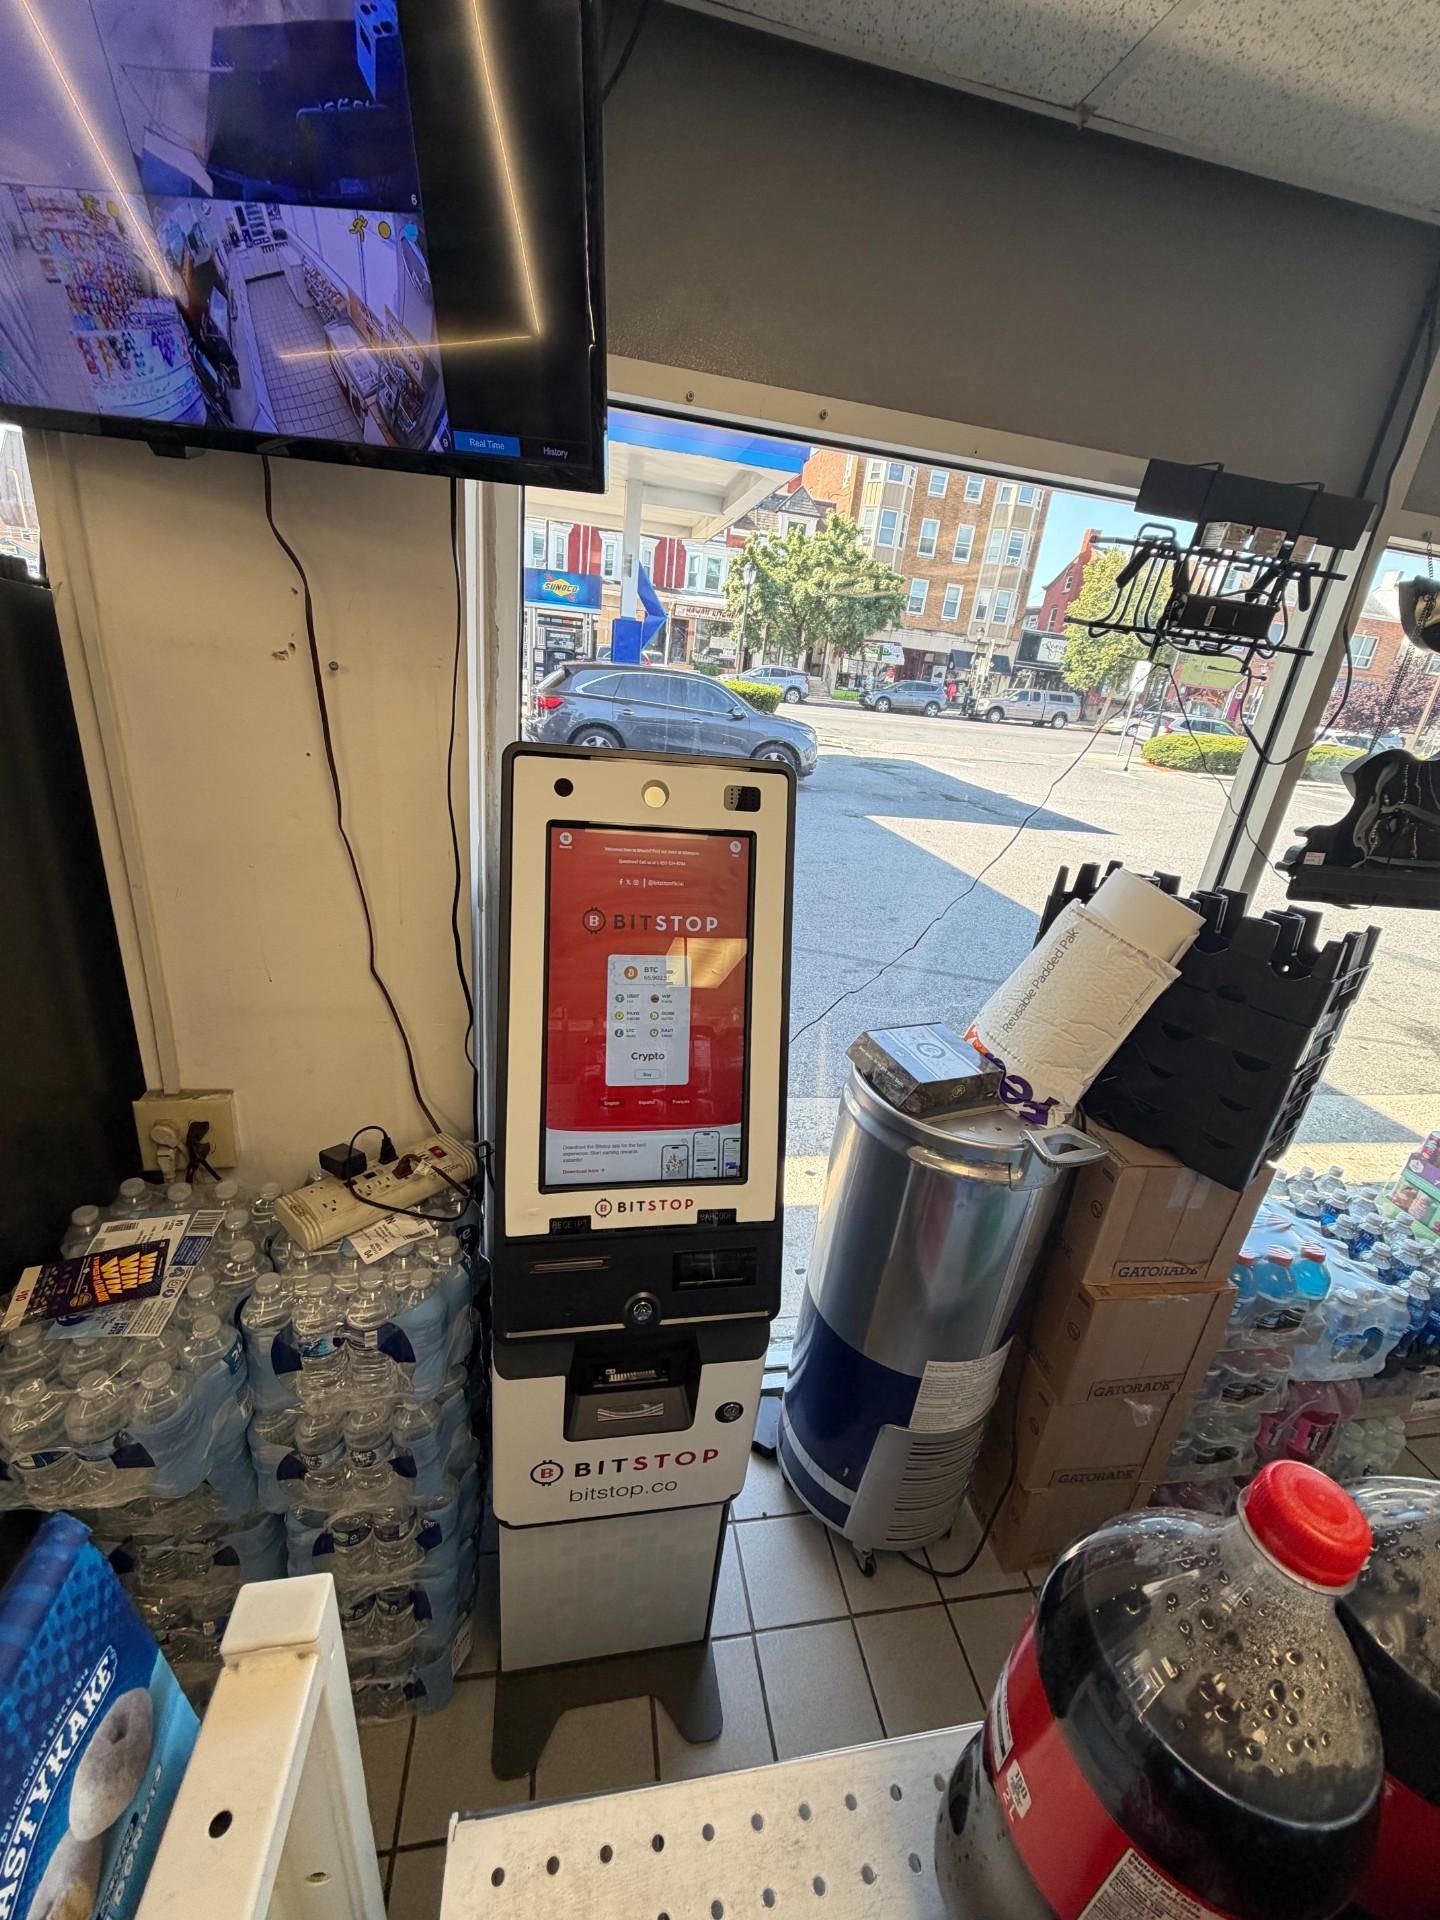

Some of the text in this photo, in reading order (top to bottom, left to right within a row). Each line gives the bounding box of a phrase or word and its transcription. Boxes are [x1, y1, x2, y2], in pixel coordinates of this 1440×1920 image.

[410, 193, 418, 206] 6
[469, 438, 505, 450] Real Time
[543, 446, 569, 460] History
[544, 582, 580, 594] SUNOCO
[613, 914, 719, 933] BITSTOP
[1002, 927, 1080, 1034] Reusable Padded Pak
[631, 1052, 665, 1062] Crypto
[617, 1198, 694, 1213] BITSTOP
[100, 1255, 123, 1294] WIN
[119, 1251, 141, 1291] WIN
[138, 1250, 159, 1286] WIN
[1117, 1266, 1199, 1278] GATORADE
[1093, 1380, 1176, 1398] GATORADE
[574, 1448, 720, 1478] BITSTOP
[1058, 1469, 1138, 1484] GATORADE
[569, 1480, 678, 1502] bitstop.co
[48, 1696, 73, 1737] SINCE
[0, 1654, 111, 1920] ASTYKAKE
